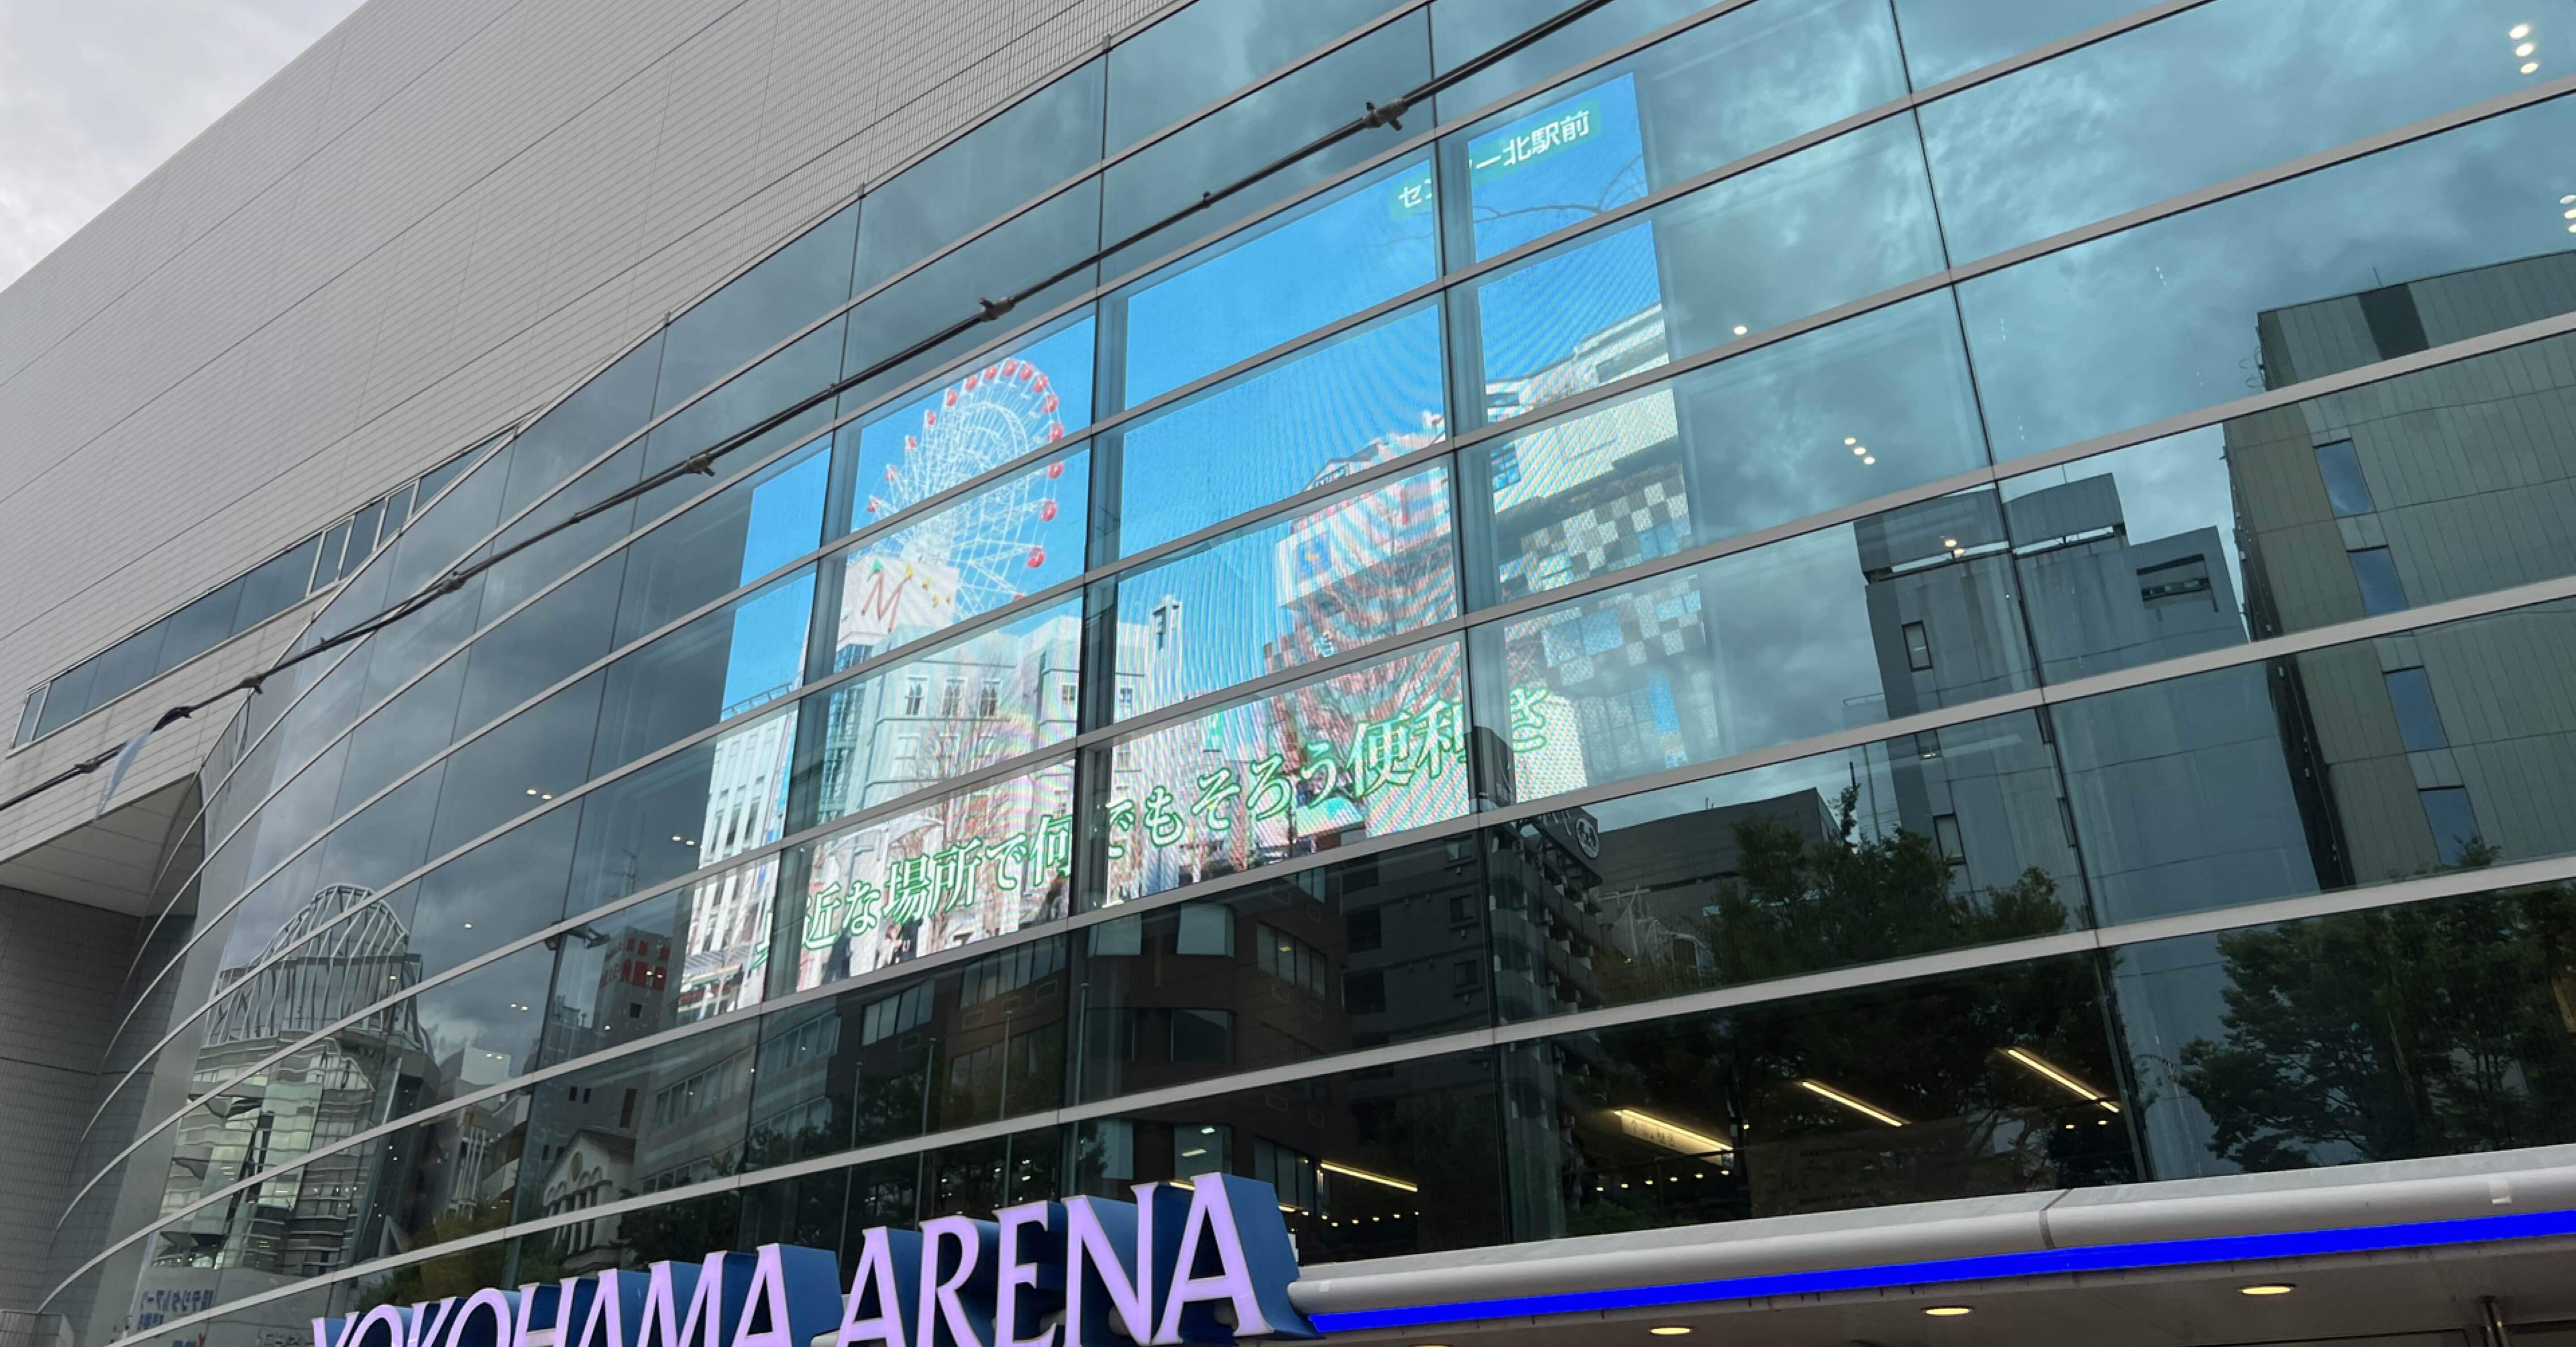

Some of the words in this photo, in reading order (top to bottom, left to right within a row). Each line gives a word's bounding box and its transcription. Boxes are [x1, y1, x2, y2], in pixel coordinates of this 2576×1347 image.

[1398, 110, 1590, 208] セー北駅前
[835, 1172, 1275, 1347] ARENA
